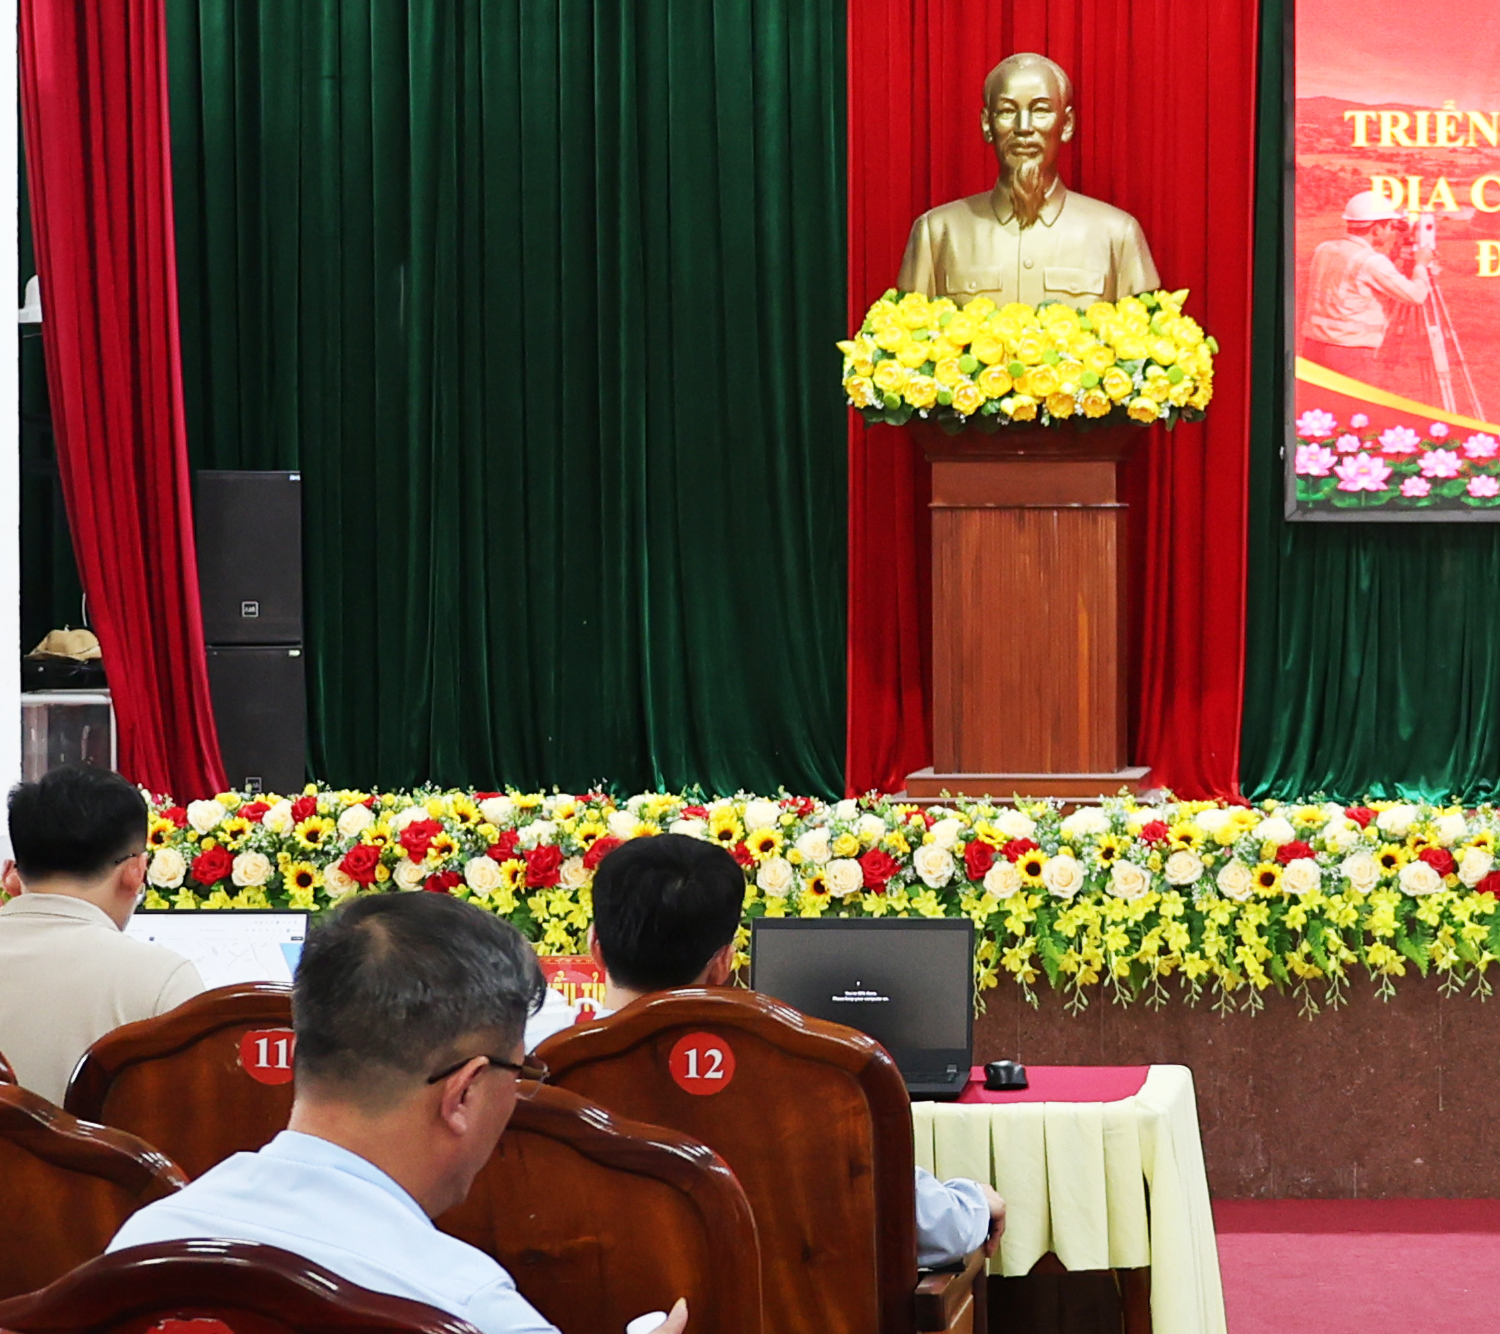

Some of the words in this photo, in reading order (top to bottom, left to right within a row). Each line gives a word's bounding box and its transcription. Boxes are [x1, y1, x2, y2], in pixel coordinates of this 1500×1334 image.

[1344, 101, 1500, 148] TRIỂN
[1370, 176, 1460, 222] ĐỊA
[255, 1038, 290, 1069] 11
[683, 1047, 724, 1081] 12
